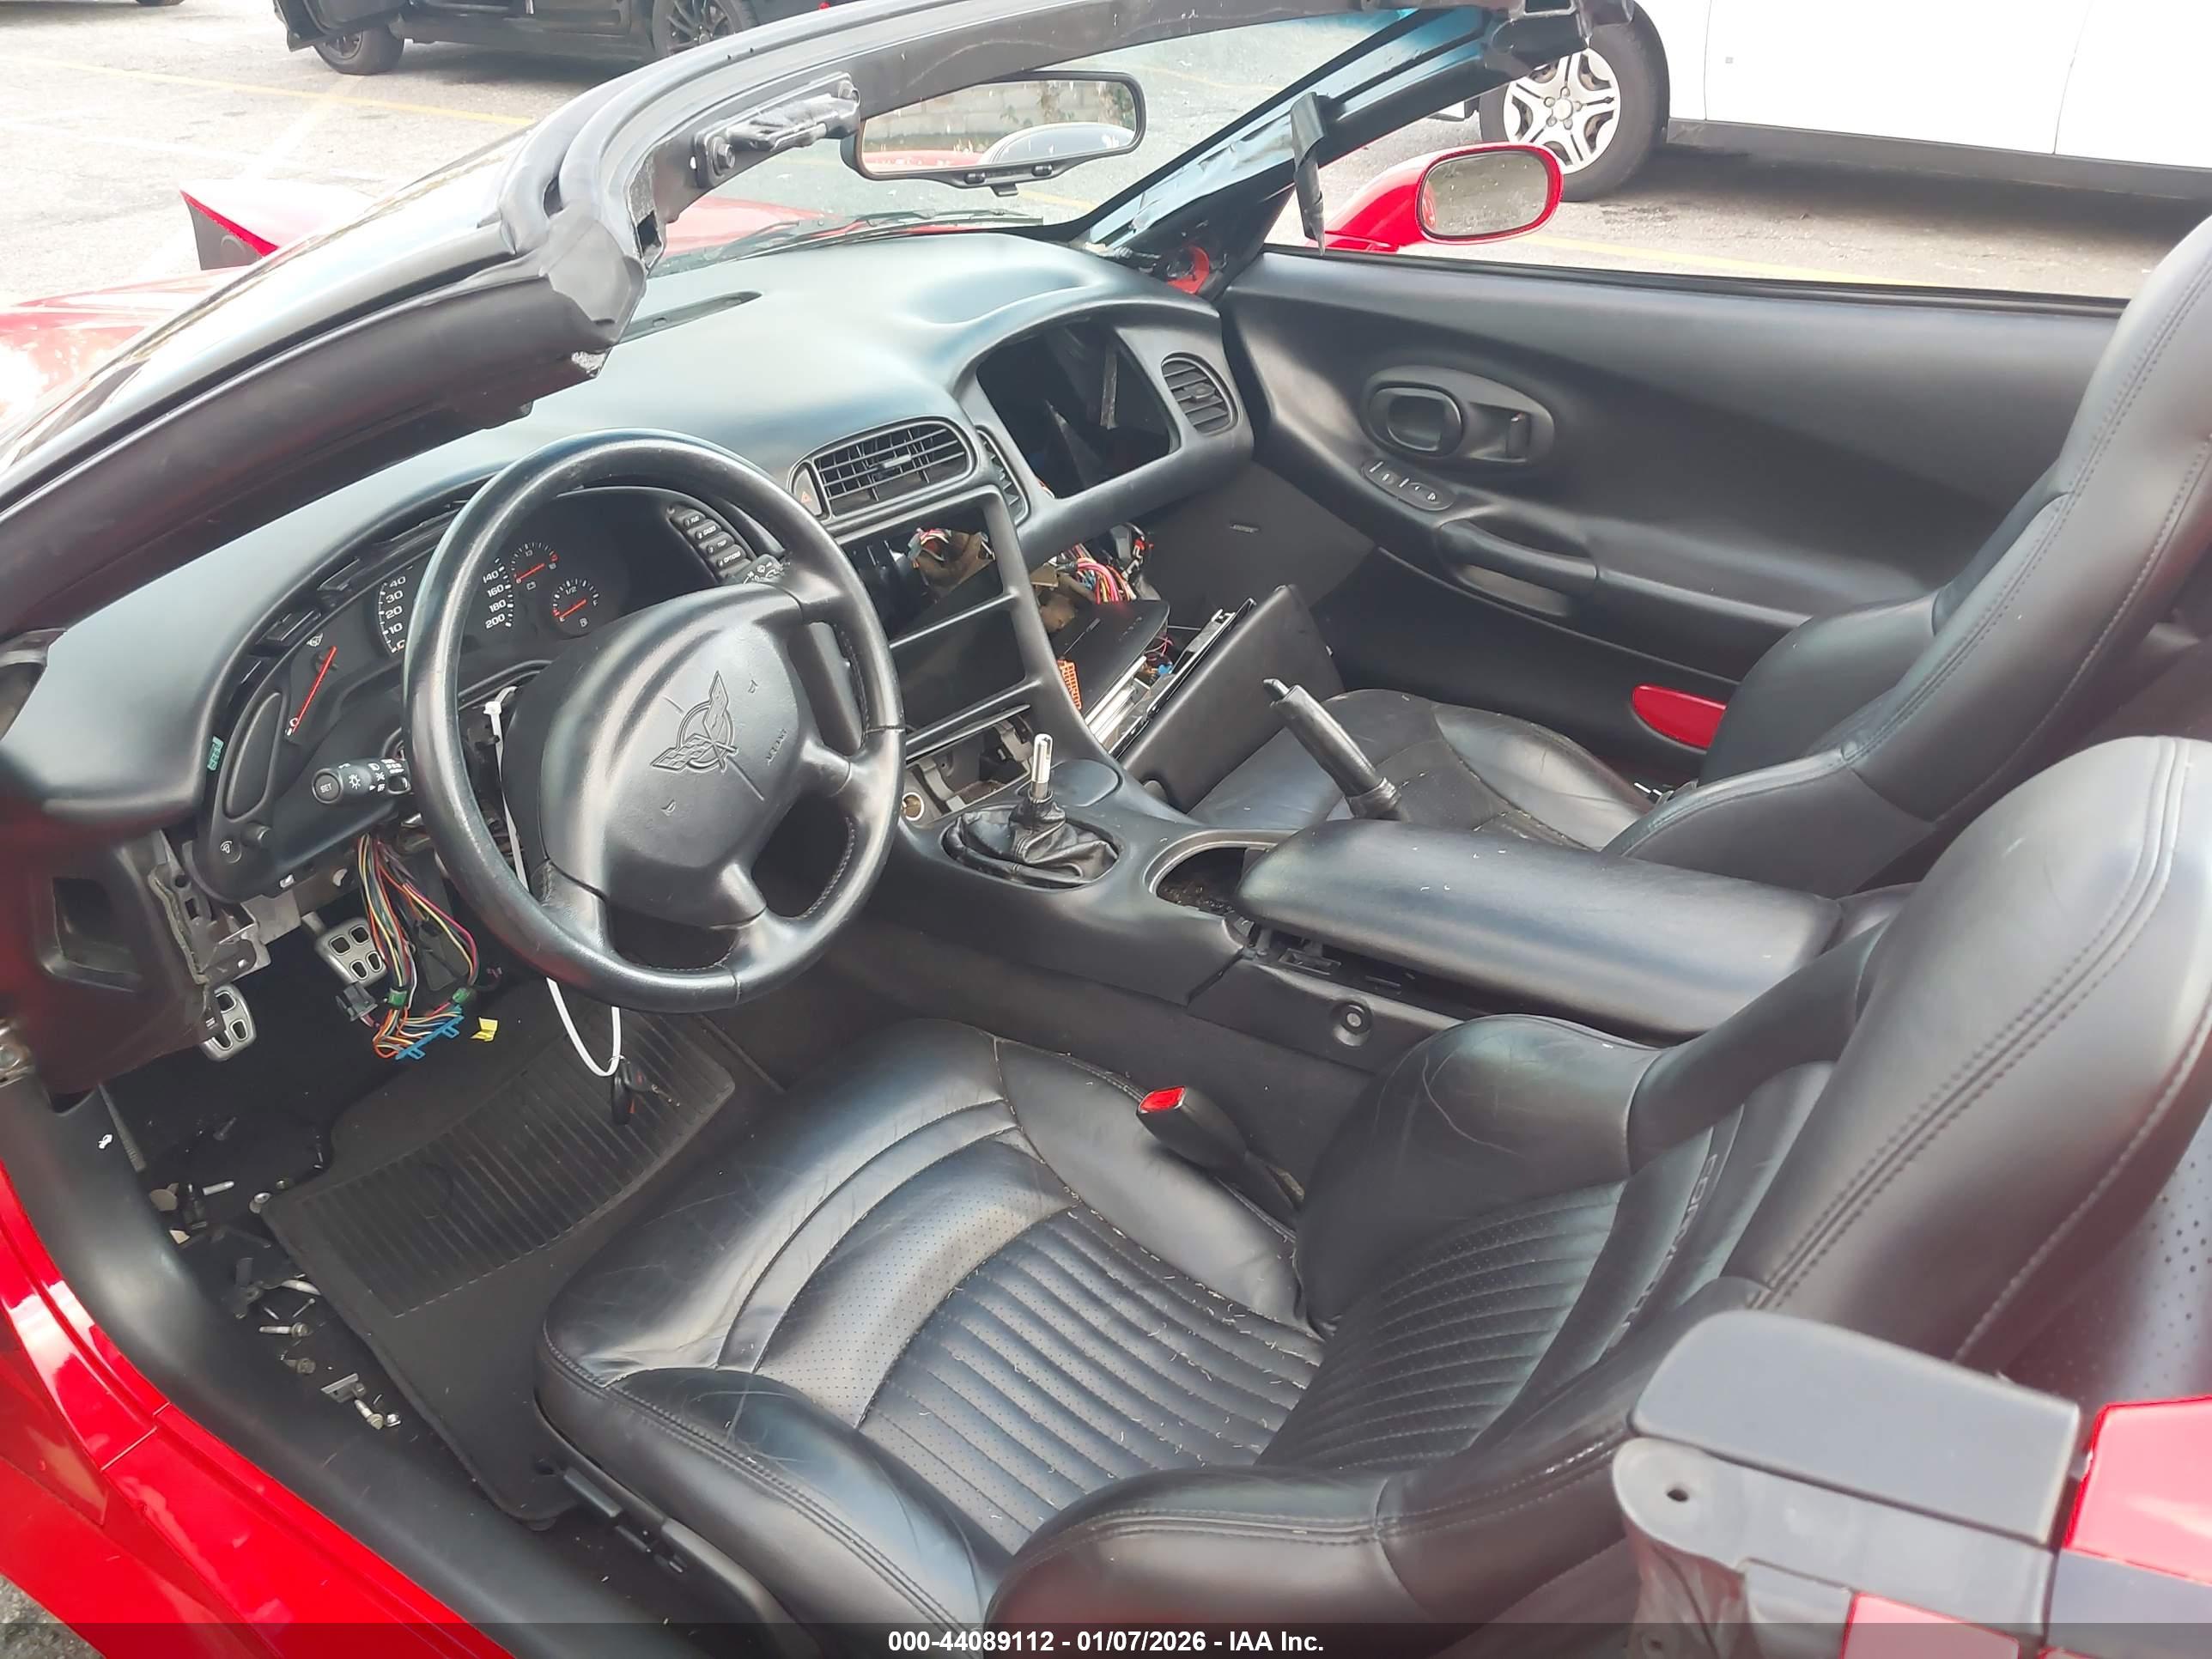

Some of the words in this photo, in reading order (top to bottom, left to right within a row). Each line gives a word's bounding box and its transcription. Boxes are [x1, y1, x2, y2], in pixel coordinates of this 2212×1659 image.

[389, 575, 406, 588] 40
[483, 570, 500, 584] 140
[386, 590, 404, 604] 30
[487, 584, 505, 598] 160
[385, 605, 404, 620] 20
[489, 599, 507, 613] 180
[484, 613, 506, 629] 200
[388, 623, 404, 635] 10
[319, 782, 332, 793] SET
